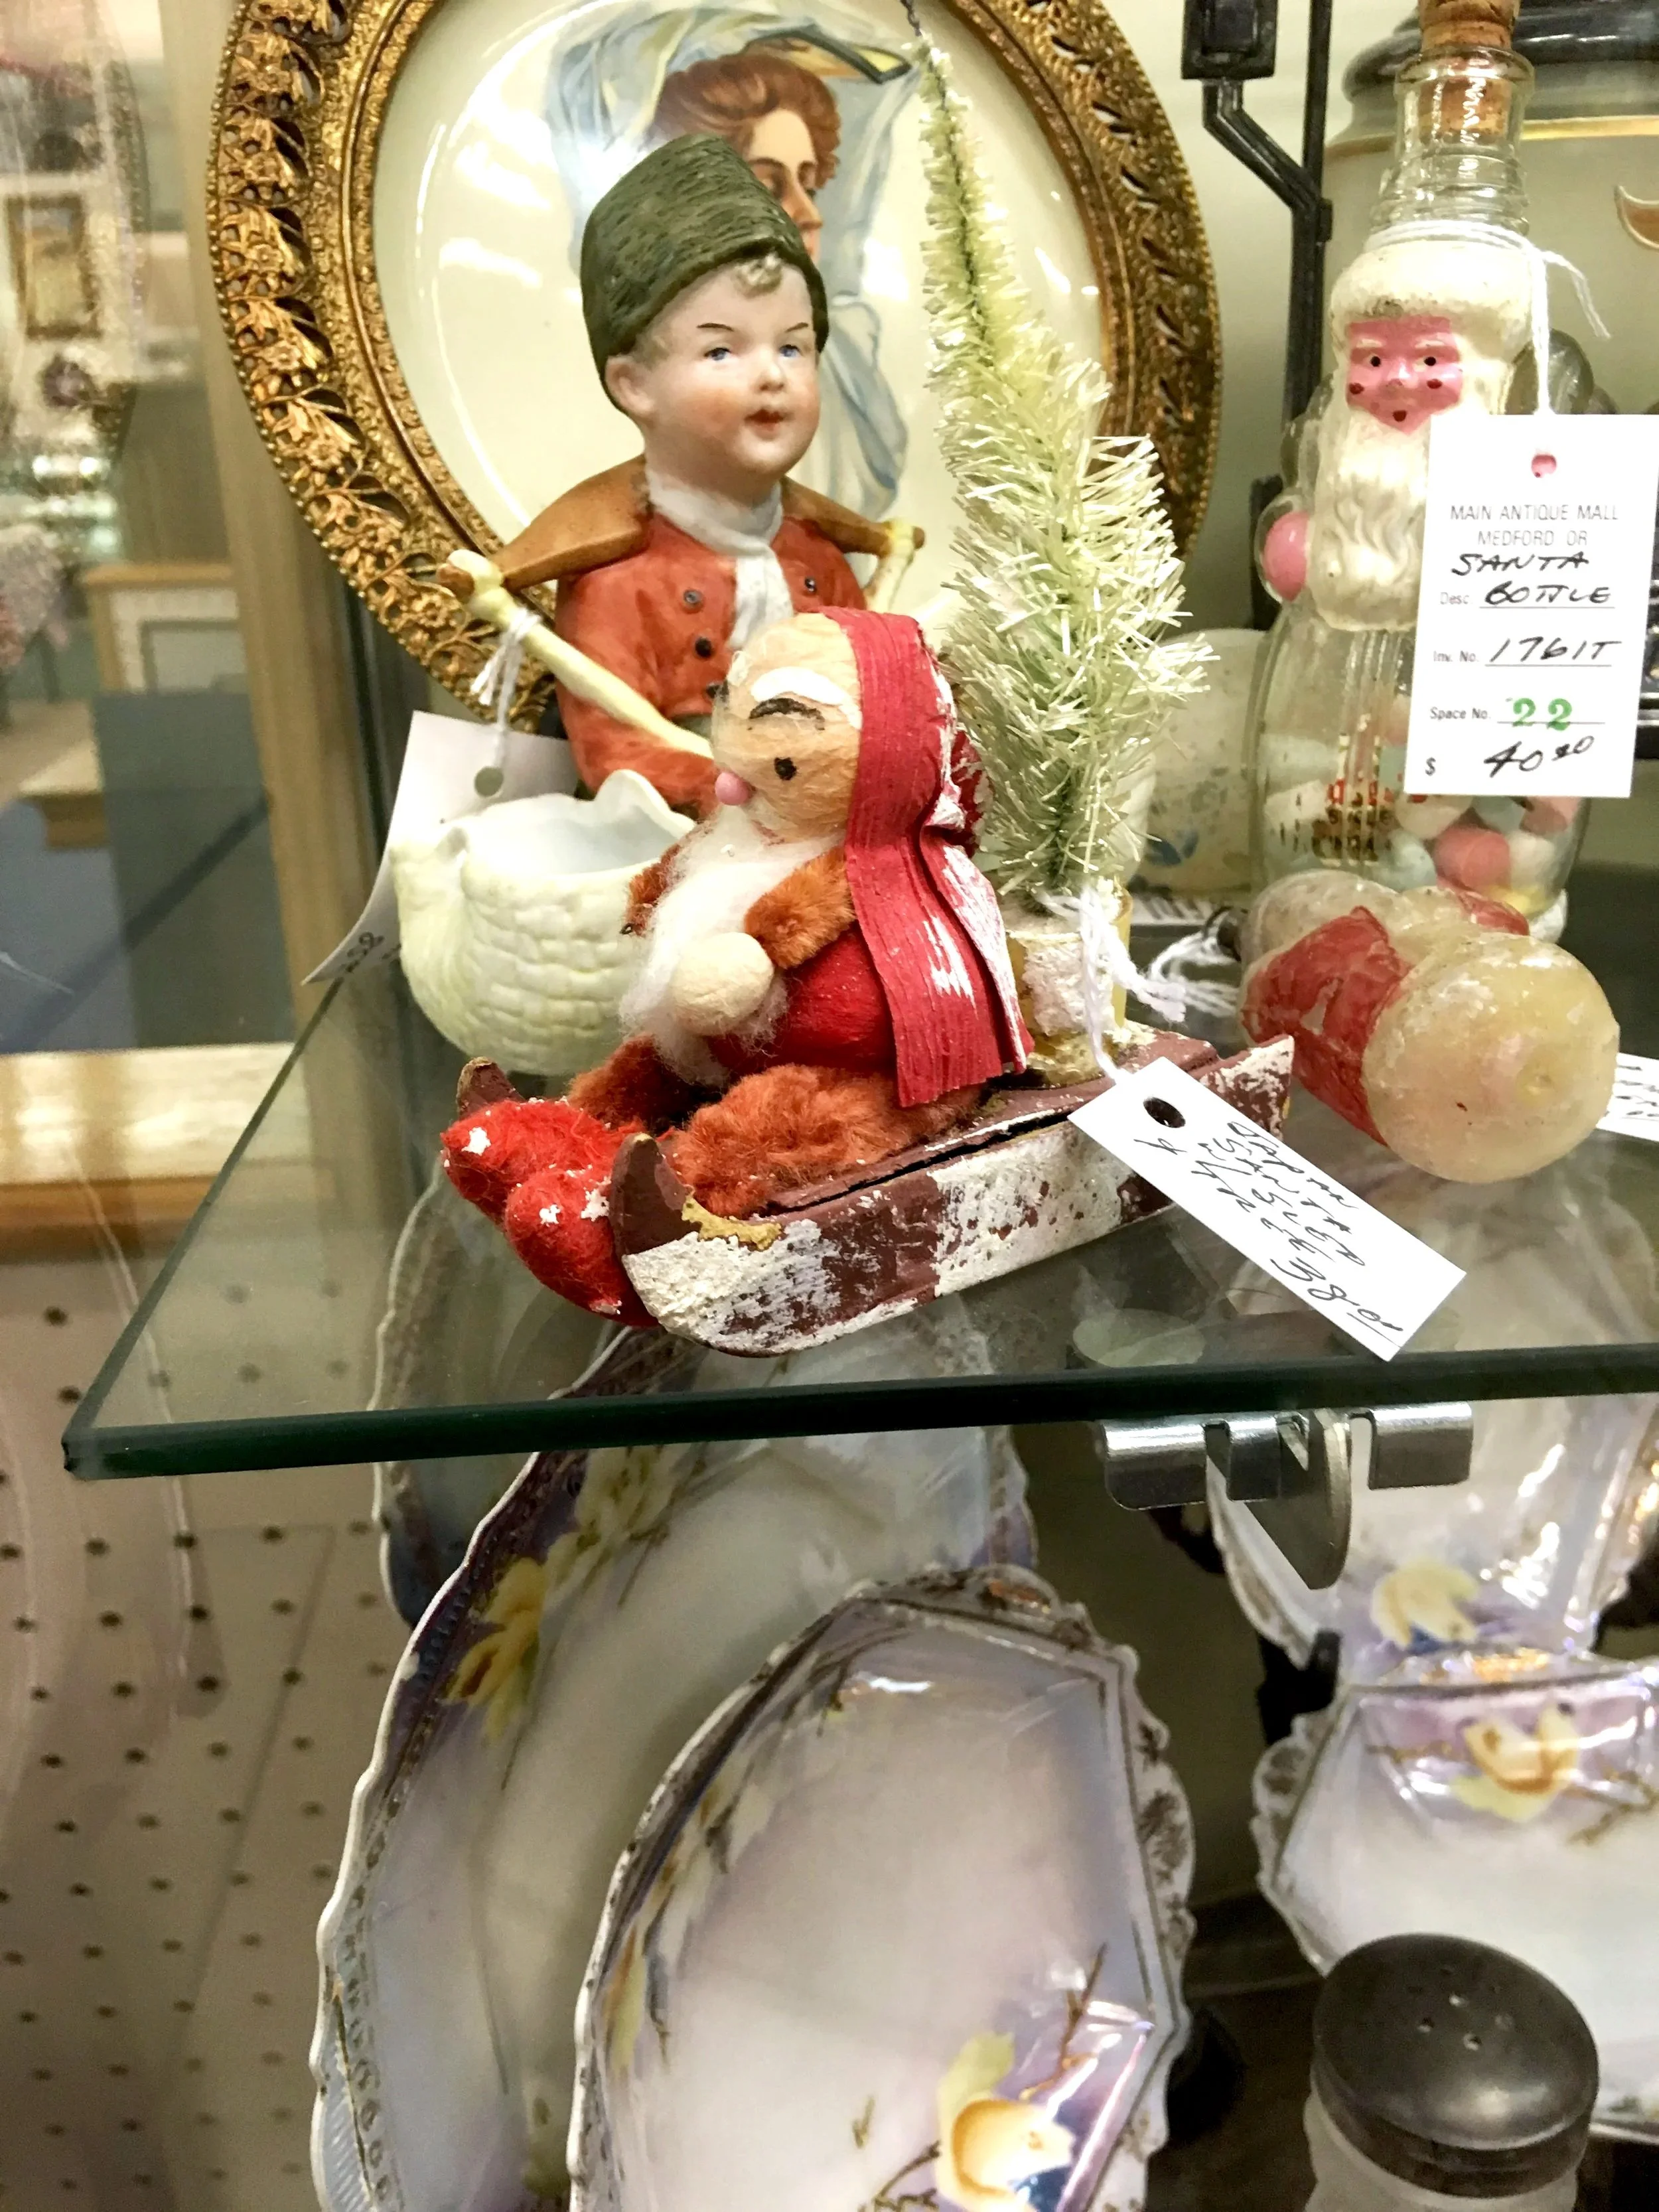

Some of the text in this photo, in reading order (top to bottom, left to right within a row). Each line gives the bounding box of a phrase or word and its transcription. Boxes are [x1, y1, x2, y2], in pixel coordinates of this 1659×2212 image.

[1450, 504, 1619, 521] MAIN ANTIQUE MALL
[1478, 530, 1588, 546] MEDFORD OR
[1451, 550, 1590, 576] SANTA
[1484, 581, 1611, 605] BOTTLE
[1429, 706, 1467, 721] Space
[1212, 1138, 1352, 1234] SANTA
